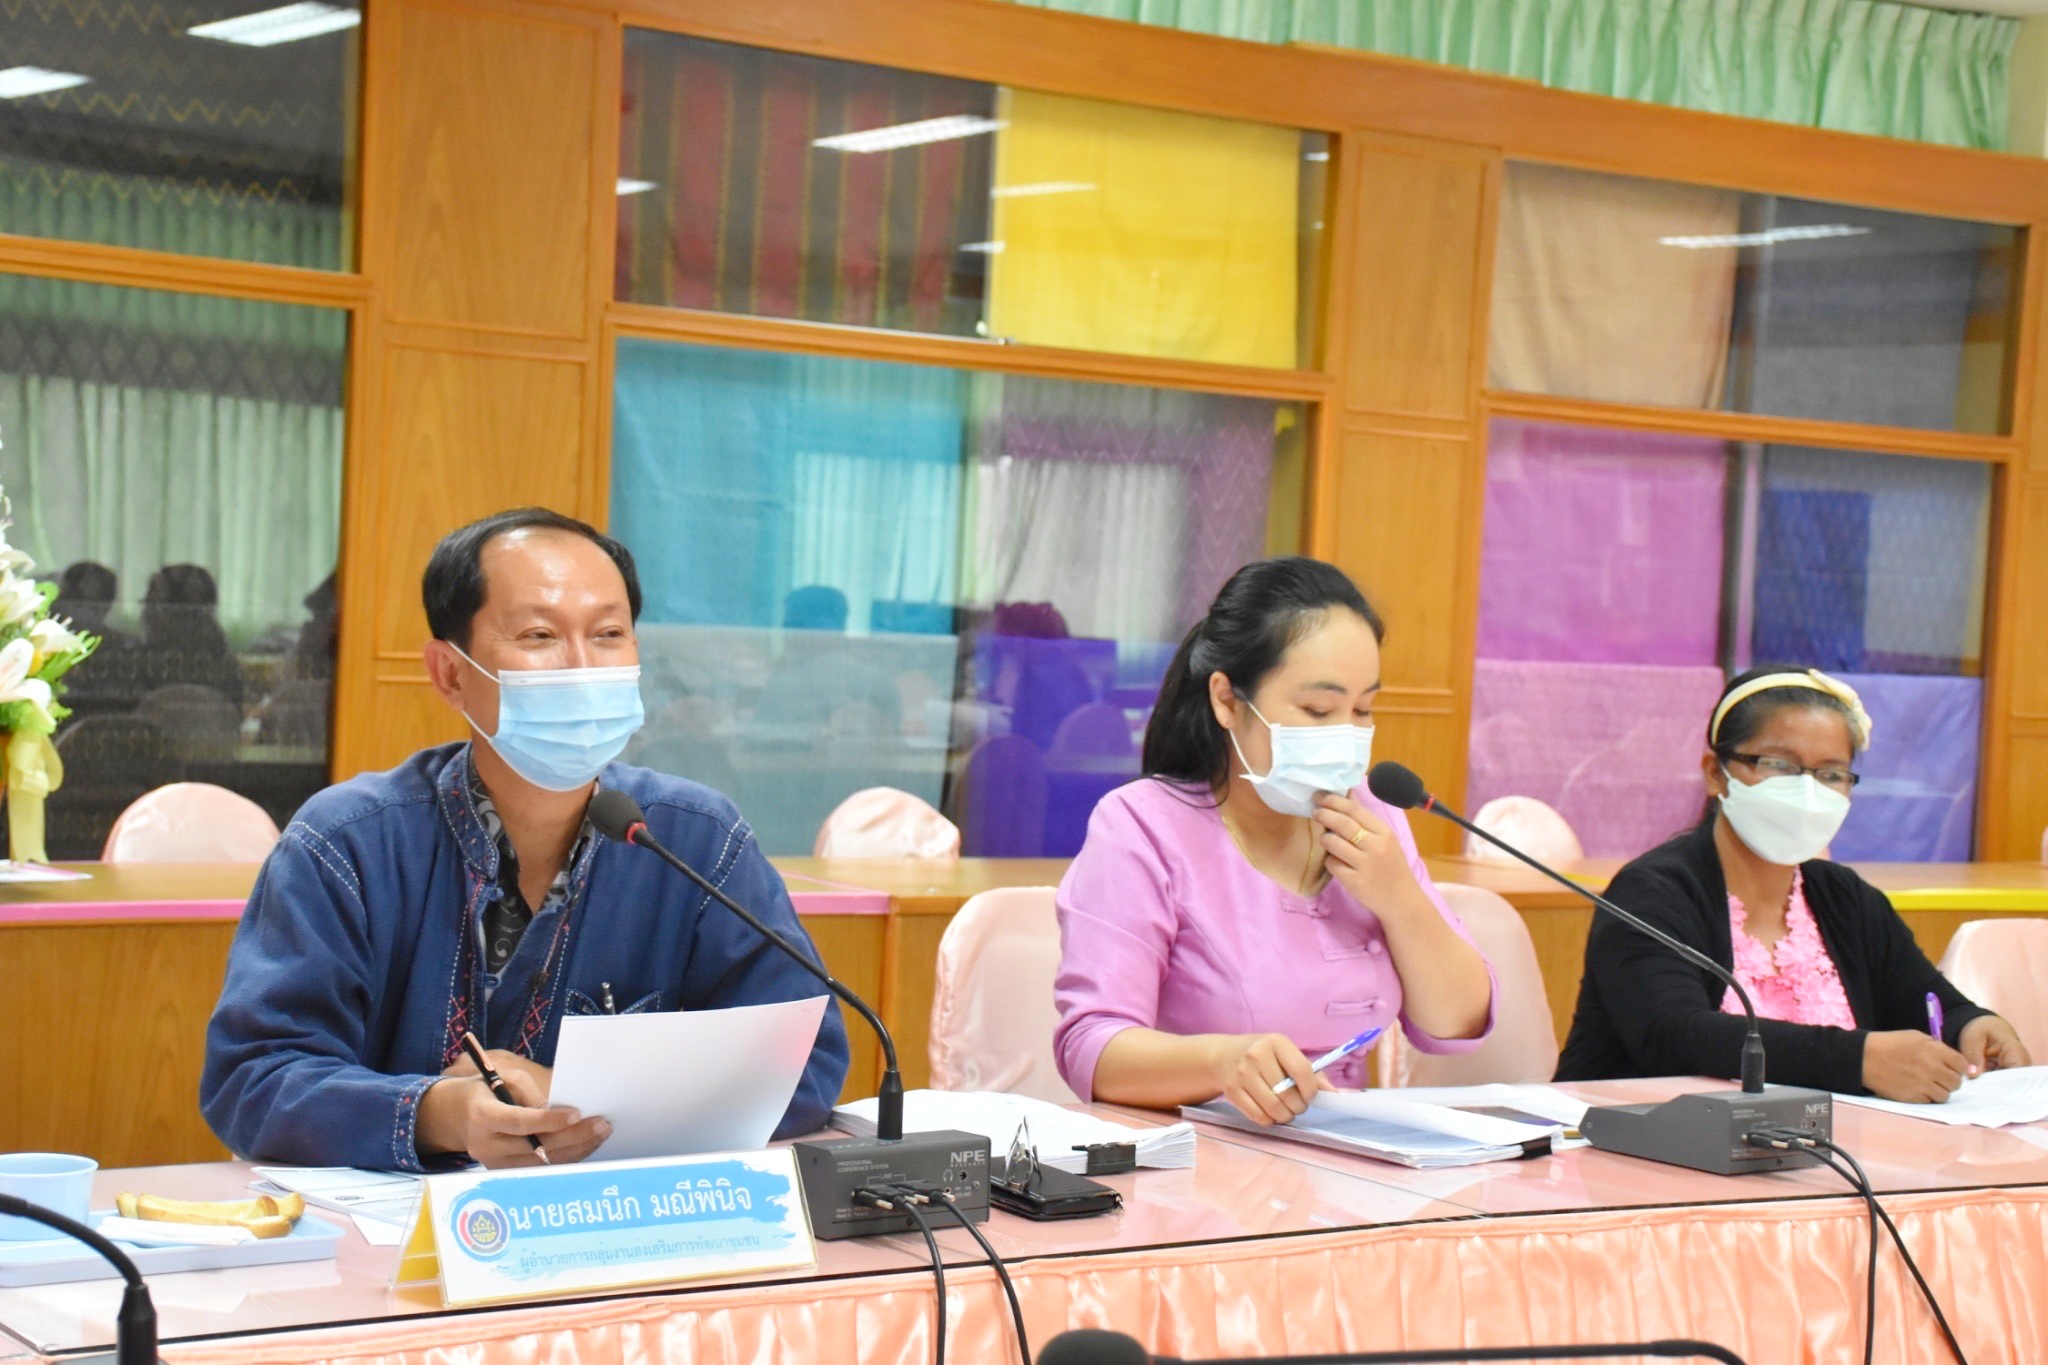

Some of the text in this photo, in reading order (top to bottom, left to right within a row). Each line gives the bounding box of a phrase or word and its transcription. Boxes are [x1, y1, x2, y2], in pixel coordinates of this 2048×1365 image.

[1805, 1103, 1829, 1114] NPE
[950, 1149, 986, 1164] NPE
[509, 1177, 752, 1231] นายสมนึก มณีพินิจ
